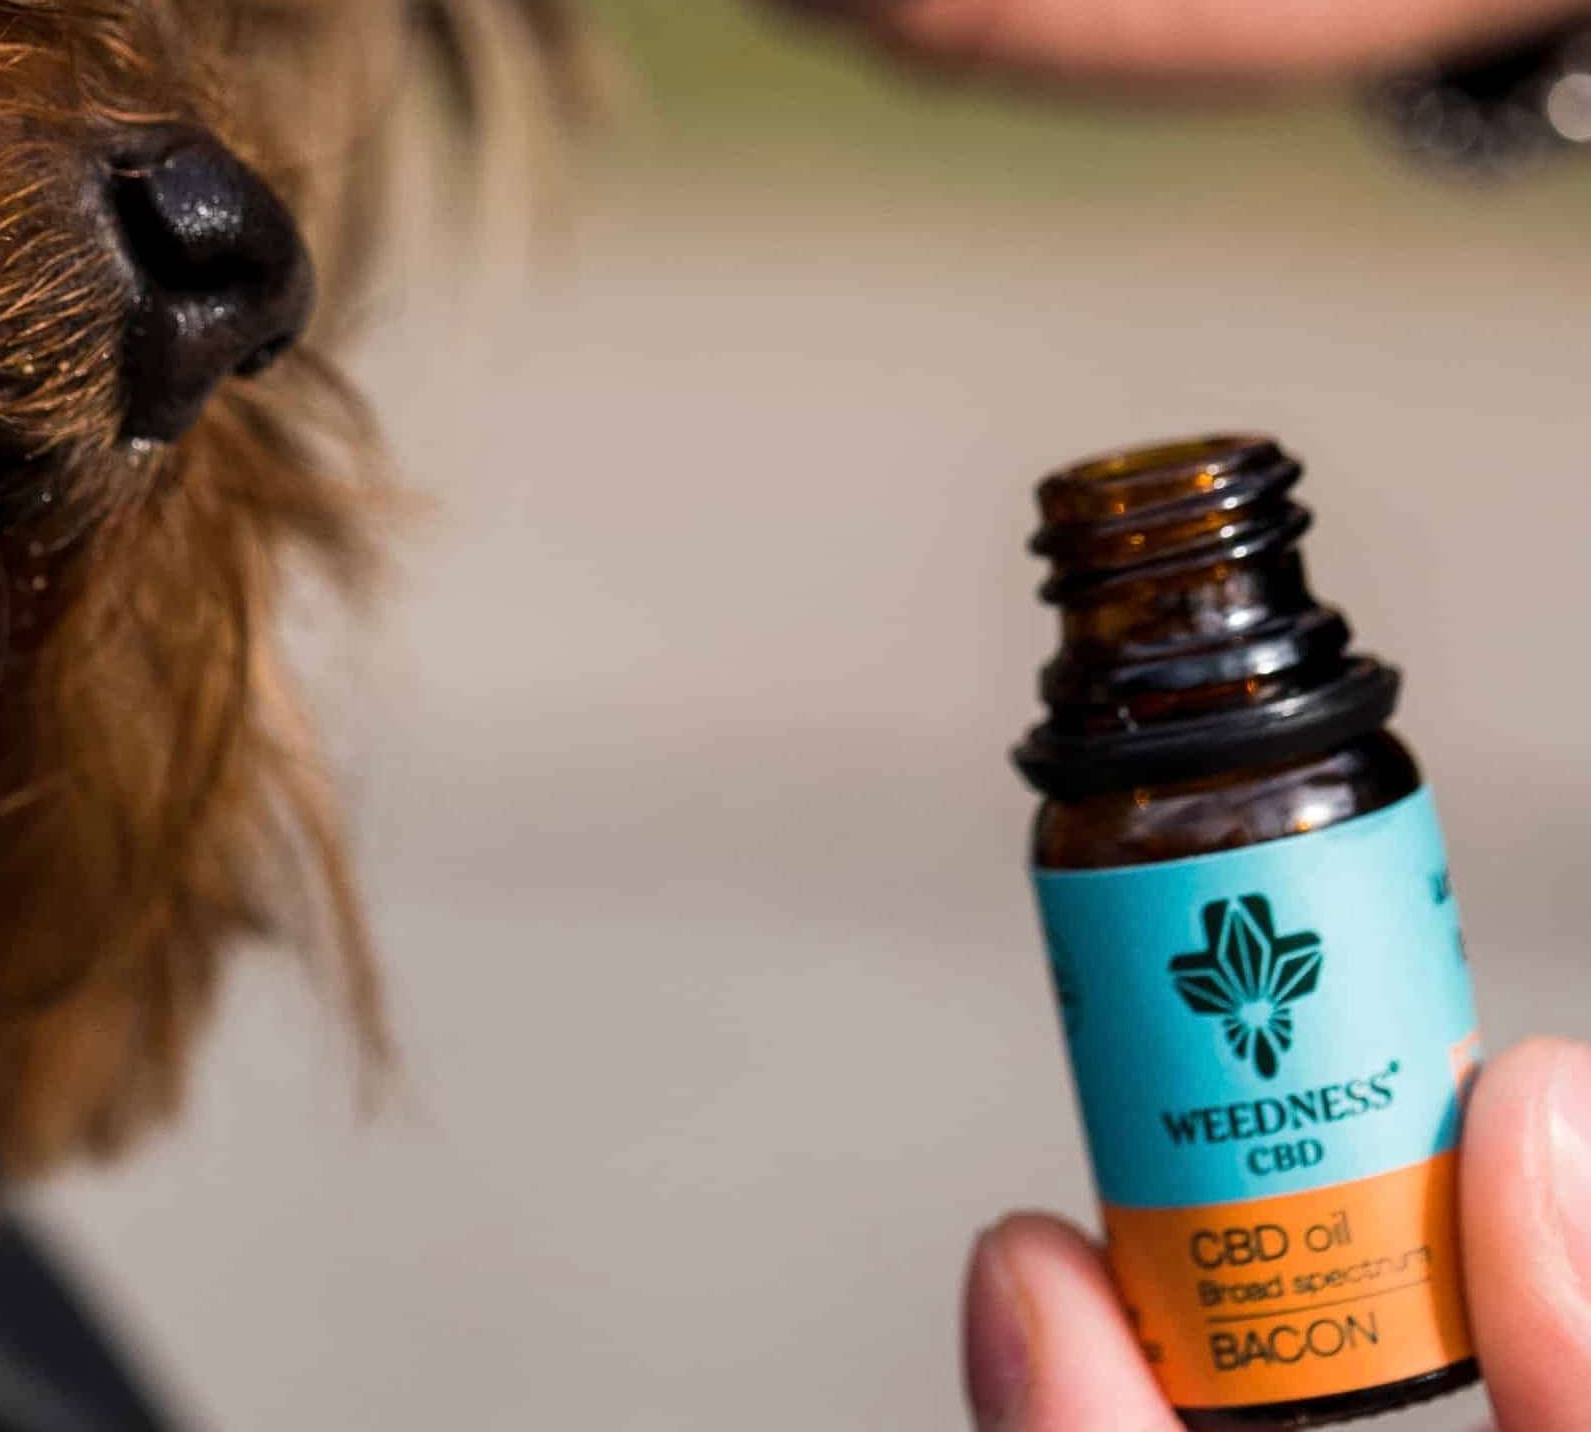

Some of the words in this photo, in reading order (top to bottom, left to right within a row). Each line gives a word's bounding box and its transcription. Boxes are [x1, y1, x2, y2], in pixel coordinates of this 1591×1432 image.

[1246, 1138, 1325, 1176] CBD
[1190, 1223, 1290, 1270] CBD
[1304, 1209, 1352, 1252] oil
[1197, 1275, 1285, 1307] Broad
[1211, 1311, 1379, 1372] BACON
